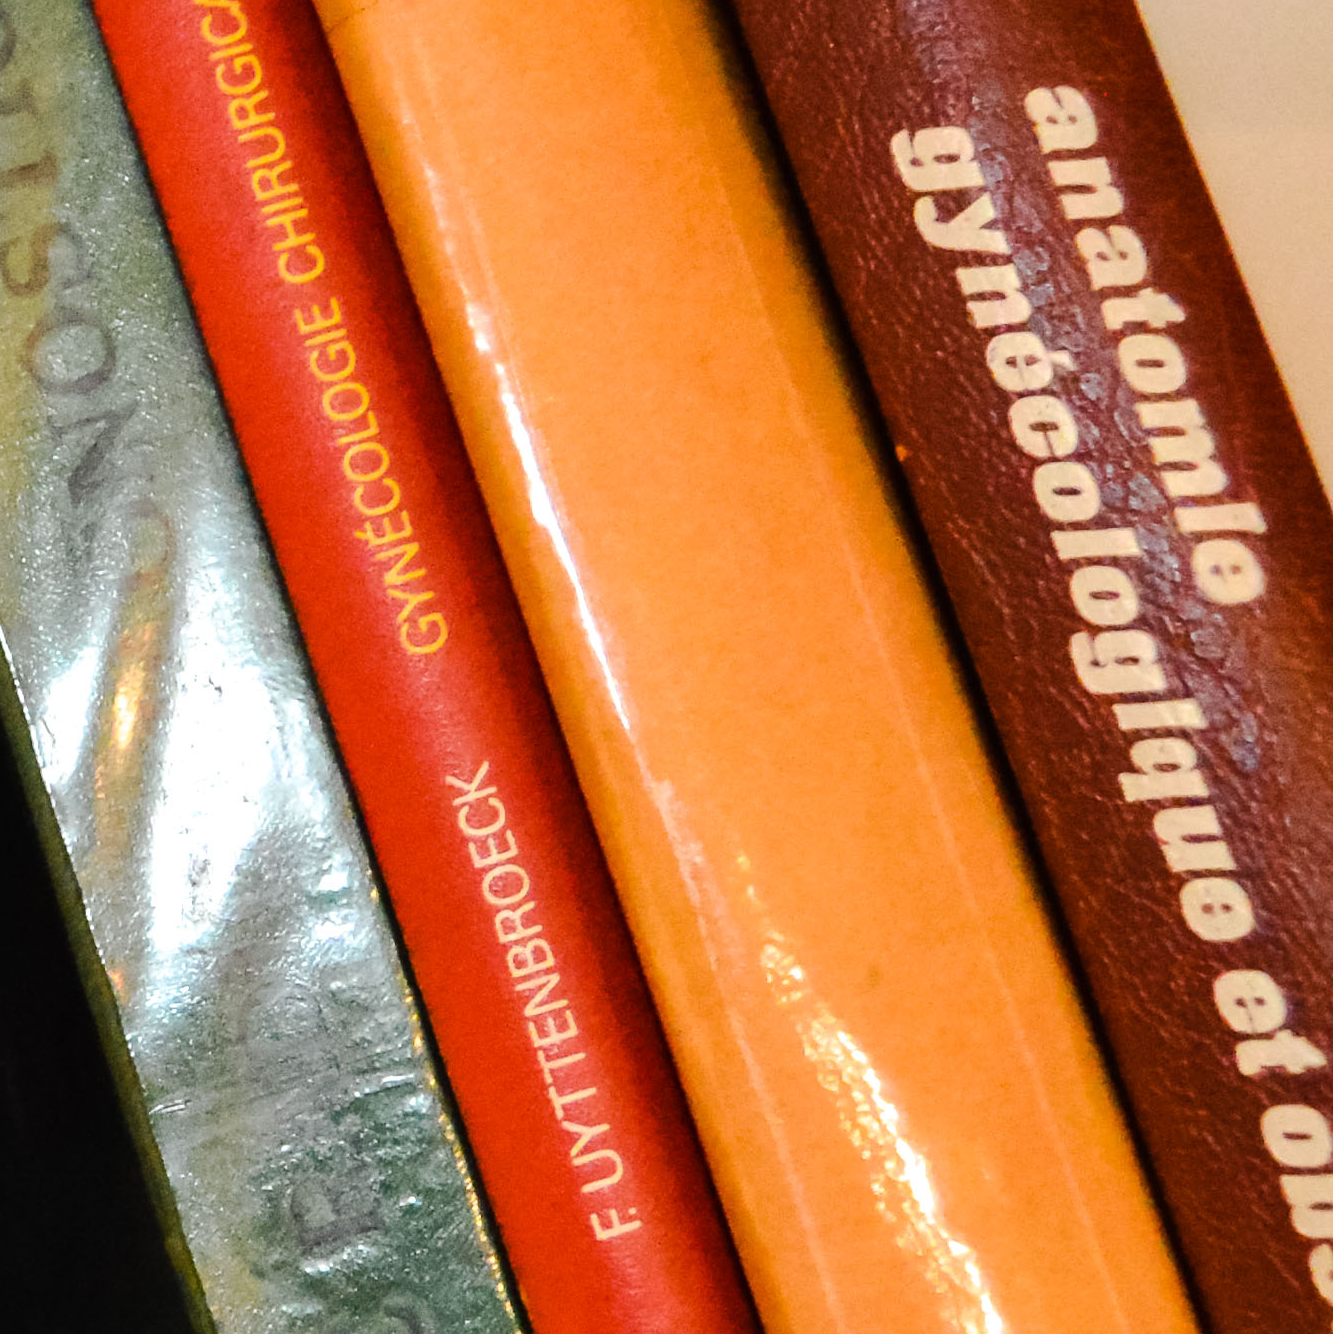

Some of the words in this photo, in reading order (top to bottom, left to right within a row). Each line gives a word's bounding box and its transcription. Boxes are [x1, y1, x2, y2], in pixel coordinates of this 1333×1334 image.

[296, 297, 449, 657] GYNÉCOLOGIE
[1024, 84, 1267, 606] anatomie
[890, 125, 1256, 943] gynécologique
[1213, 969, 1327, 1076] et
[445, 759, 625, 1195] UYTTENBROECK
